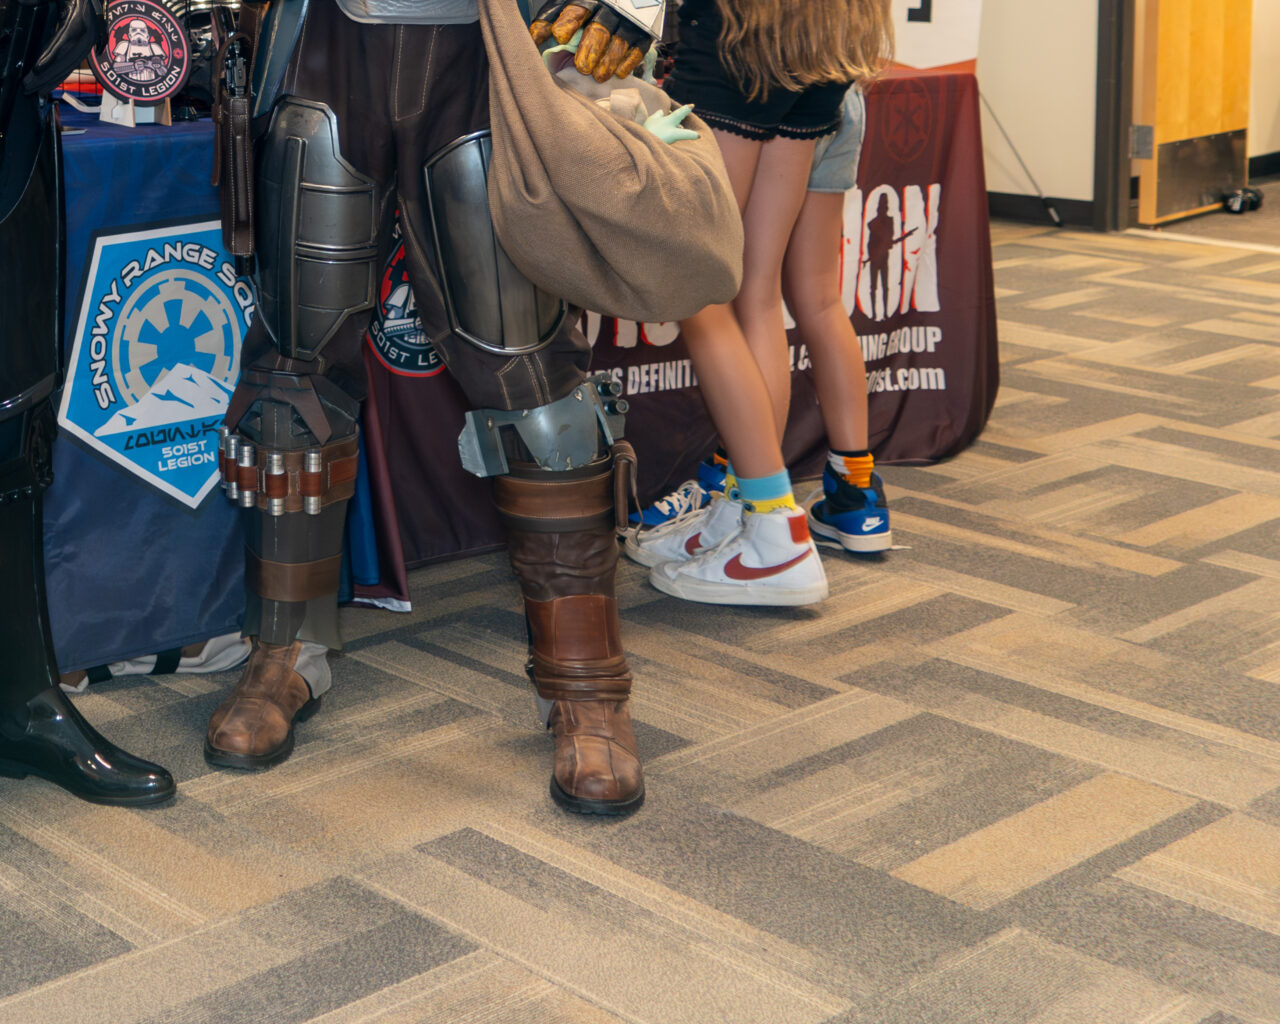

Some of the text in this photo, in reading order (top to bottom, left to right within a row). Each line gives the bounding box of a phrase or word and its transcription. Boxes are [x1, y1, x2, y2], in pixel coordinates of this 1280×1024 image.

[142, 65, 181, 96] LEGION
[90, 241, 219, 410] SNOWY RANGE
[161, 440, 207, 457] 501ST
[158, 452, 216, 472] LEGION
